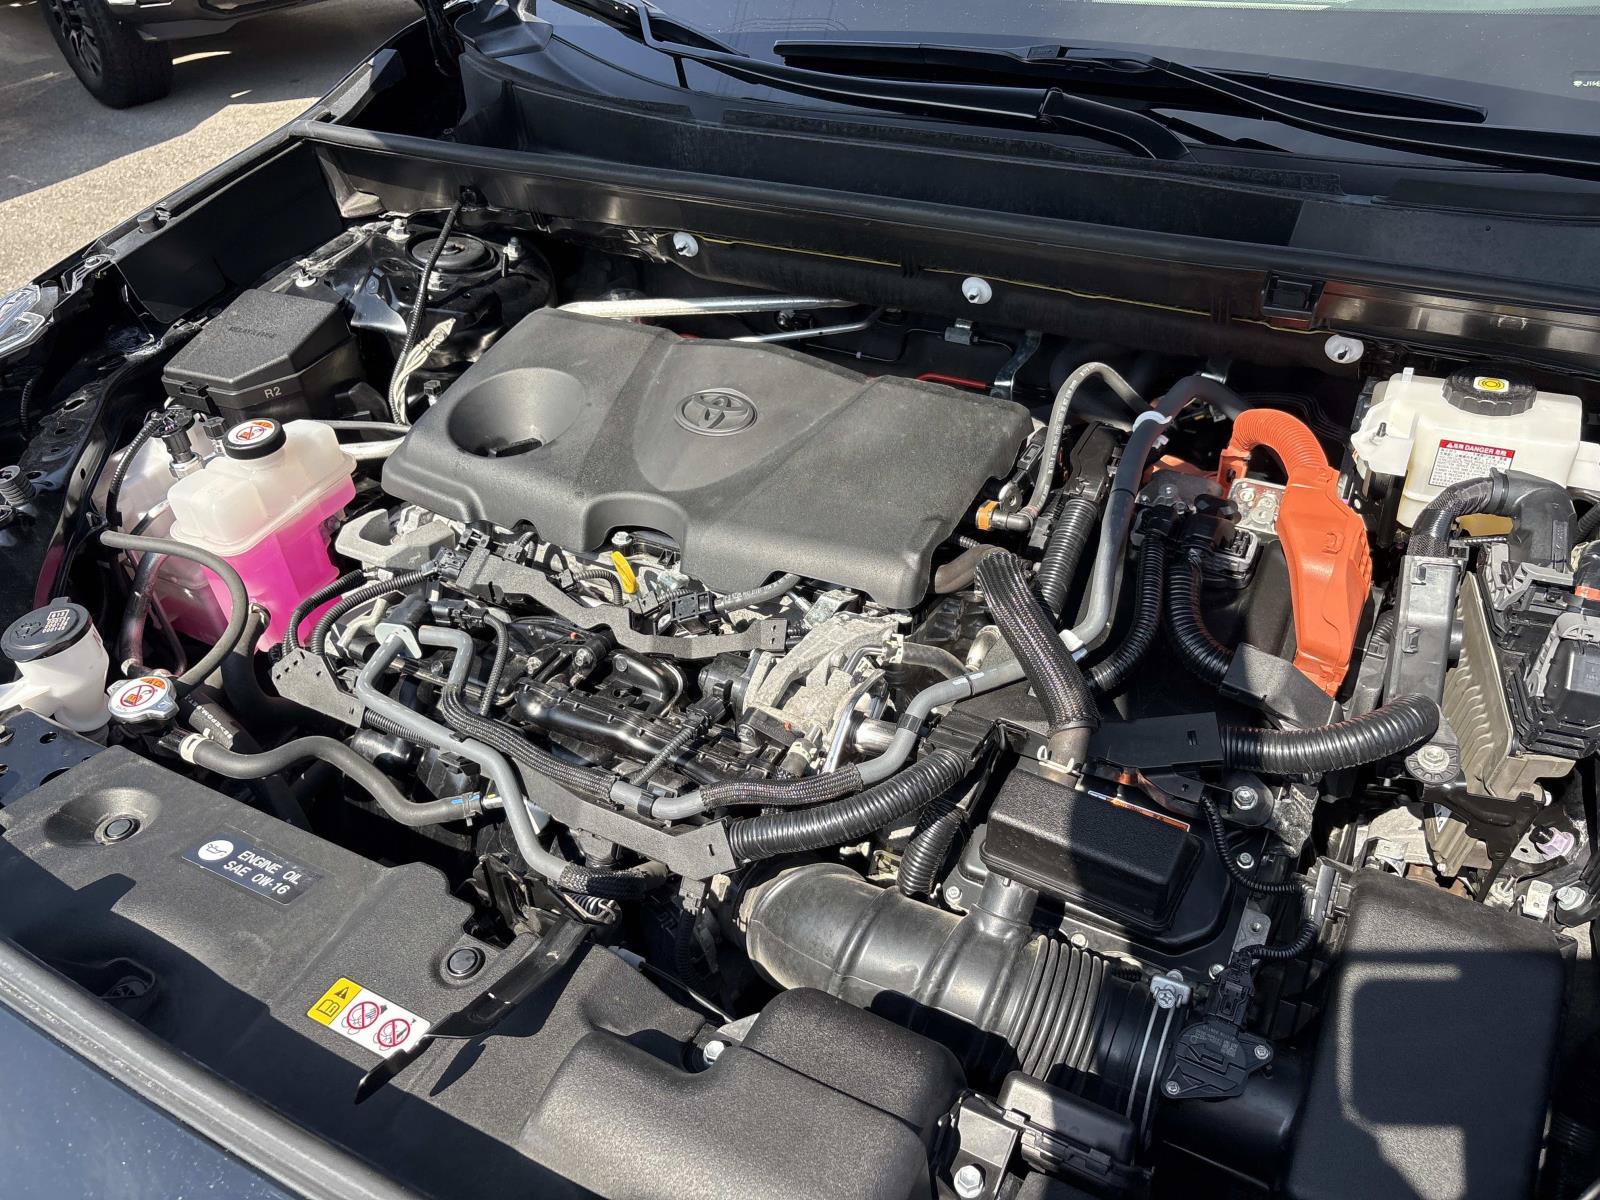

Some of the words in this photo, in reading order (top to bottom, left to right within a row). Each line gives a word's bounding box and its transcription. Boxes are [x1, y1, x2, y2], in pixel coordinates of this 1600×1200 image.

[264, 386, 282, 399] R2
[1465, 445, 1494, 455] DANGER
[223, 860, 252, 877] SAE
[251, 873, 290, 895] 0W-16
[238, 850, 283, 874] ENGINE
[283, 871, 302, 885] OIL
